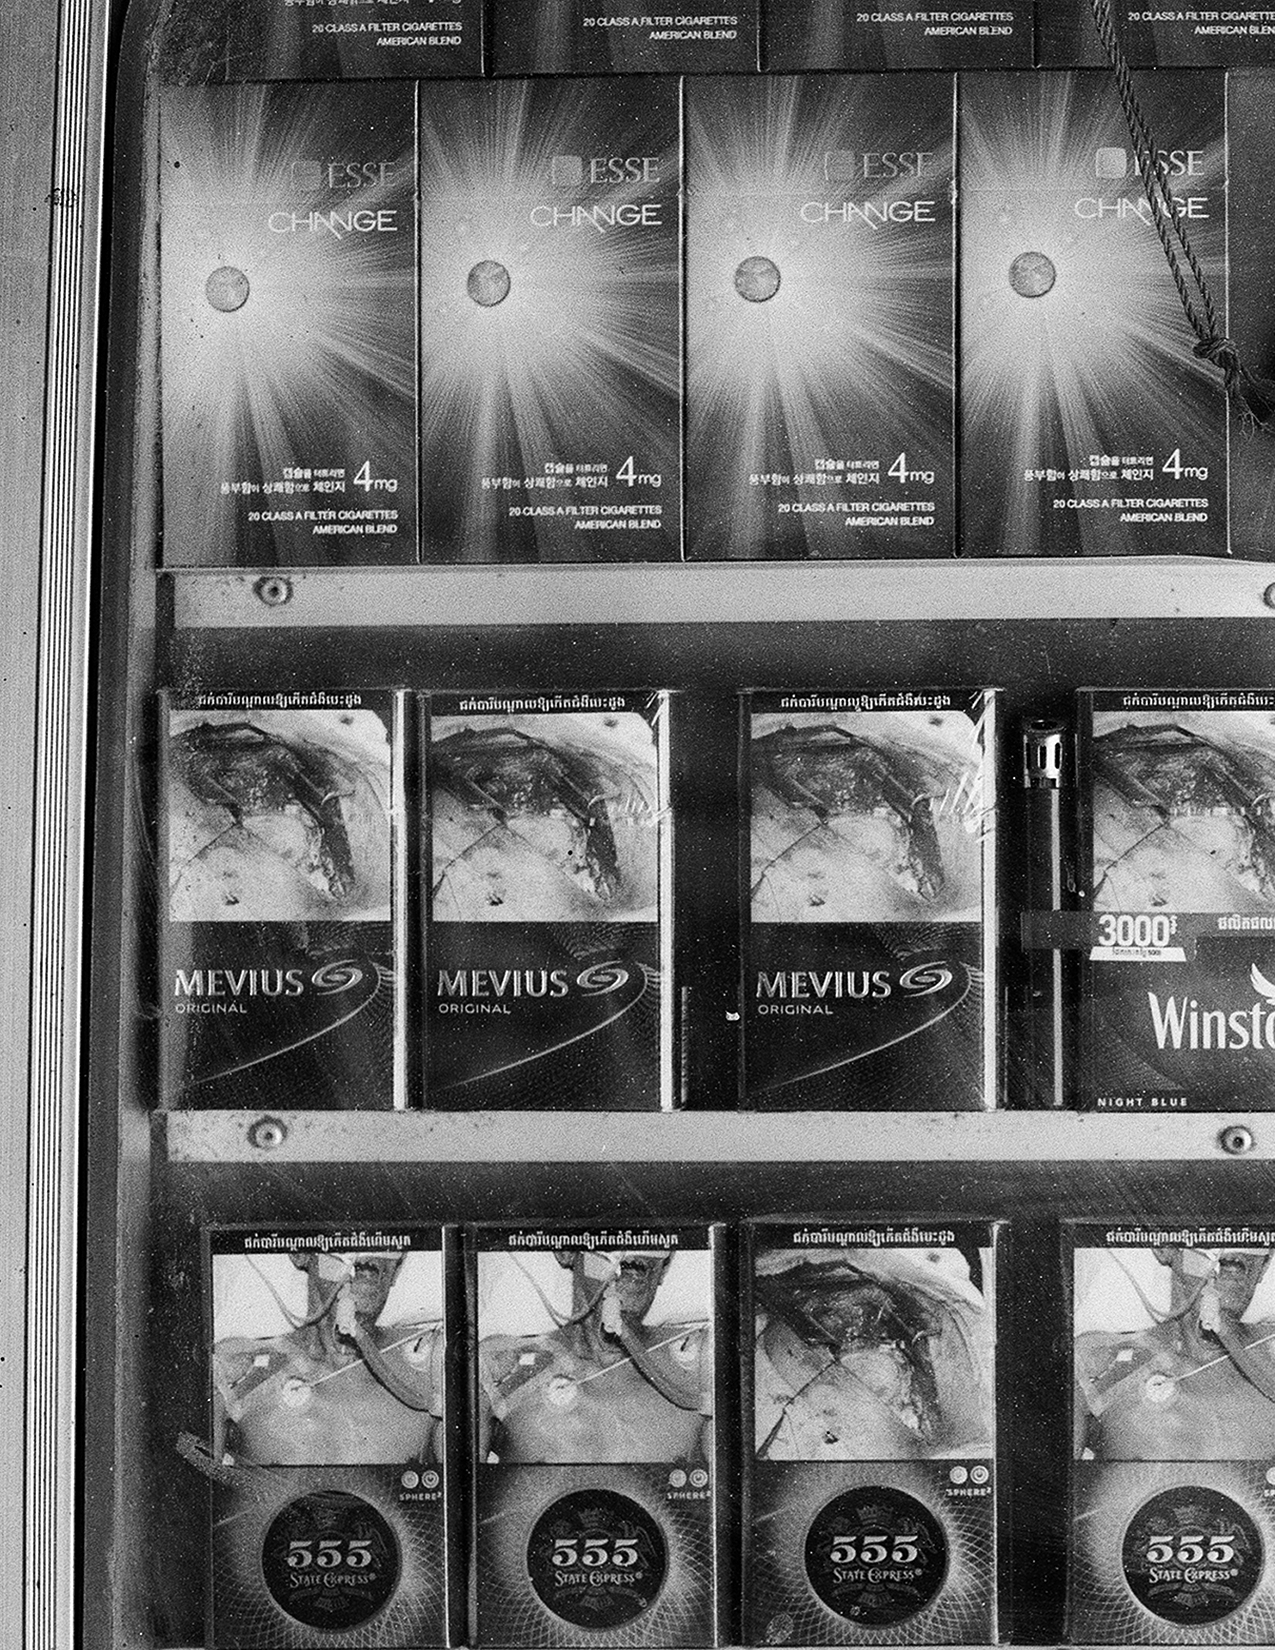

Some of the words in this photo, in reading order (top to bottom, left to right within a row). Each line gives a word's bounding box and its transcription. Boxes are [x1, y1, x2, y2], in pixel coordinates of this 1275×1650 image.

[583, 18, 595, 27] 20
[597, 17, 630, 26] CLASS
[631, 17, 639, 26] A
[641, 16, 673, 26] FILTER
[675, 16, 738, 25] CIGARETTES
[857, 13, 869, 22] 20
[871, 13, 904, 22] CLASS
[906, 13, 914, 22] A
[916, 12, 948, 22] FILTER
[950, 12, 1014, 21] CIGARETTES
[1128, 12, 1141, 21] 20
[1142, 12, 1175, 21] CLASS
[1177, 12, 1185, 21] A
[1186, 12, 1219, 21] FILTER
[312, 24, 324, 33] 20
[325, 23, 358, 33] CLASS
[359, 23, 367, 32] A
[368, 23, 400, 32] FILTER
[402, 22, 462, 31] CIGARETTES
[925, 26, 977, 35] AMERICAN
[979, 26, 1013, 35] BLEND
[1195, 26, 1247, 35] AMERICAN
[377, 36, 426, 46] AMERICAN
[429, 35, 461, 45] BLEND
[650, 30, 701, 40] AMERICAN
[703, 30, 737, 39] BLEND
[590, 157, 662, 185] ESSE
[862, 152, 934, 178] ESSE
[328, 162, 397, 189] ESSE
[530, 204, 663, 233] CHANGE
[800, 201, 936, 230] CHANGE
[267, 209, 398, 240] CHANGE
[778, 503, 790, 513] 20
[791, 503, 825, 513] CLASS
[826, 502, 835, 512] A
[836, 502, 870, 512] FILTER
[871, 501, 935, 512] CIGARETTES
[1053, 499, 1066, 509] 20
[1067, 499, 1100, 509] CLASS
[1101, 499, 1110, 509] A
[1111, 498, 1145, 508] FILTER
[1145, 498, 1209, 508] CIGARETTES
[248, 512, 260, 521] 20
[261, 511, 294, 521] CLASS
[295, 511, 303, 521] A
[304, 510, 337, 520] FILTER
[338, 509, 398, 520] CIGARETTES
[509, 507, 522, 516] 20
[522, 506, 556, 516] CLASS
[557, 506, 565, 515] A
[565, 505, 599, 515] FILTER
[600, 505, 663, 515] CIGARETTES
[845, 516, 898, 526] AMERICAN
[900, 516, 935, 526] BLEND
[1119, 512, 1173, 523] AMERICAN
[1174, 512, 1209, 522] BLEND
[313, 525, 363, 535] AMERICAN
[365, 524, 398, 534] BLEND
[574, 520, 627, 530] AMERICAN
[628, 519, 662, 529] BLEND
[174, 969, 304, 997] MEVIUS
[436, 969, 569, 997] MEVIUS
[756, 970, 892, 999] MEVIUS
[175, 1003, 248, 1015] ORIGINAL
[438, 1003, 512, 1015] ORIGINAL
[757, 1004, 834, 1015] ORIGINAL
[1097, 1097, 1143, 1107] NIGHT
[1151, 1097, 1188, 1107] BLUE
[286, 1540, 373, 1568] 555
[552, 1538, 639, 1567] 555
[830, 1535, 919, 1563] 555
[1146, 1535, 1235, 1563] 555
